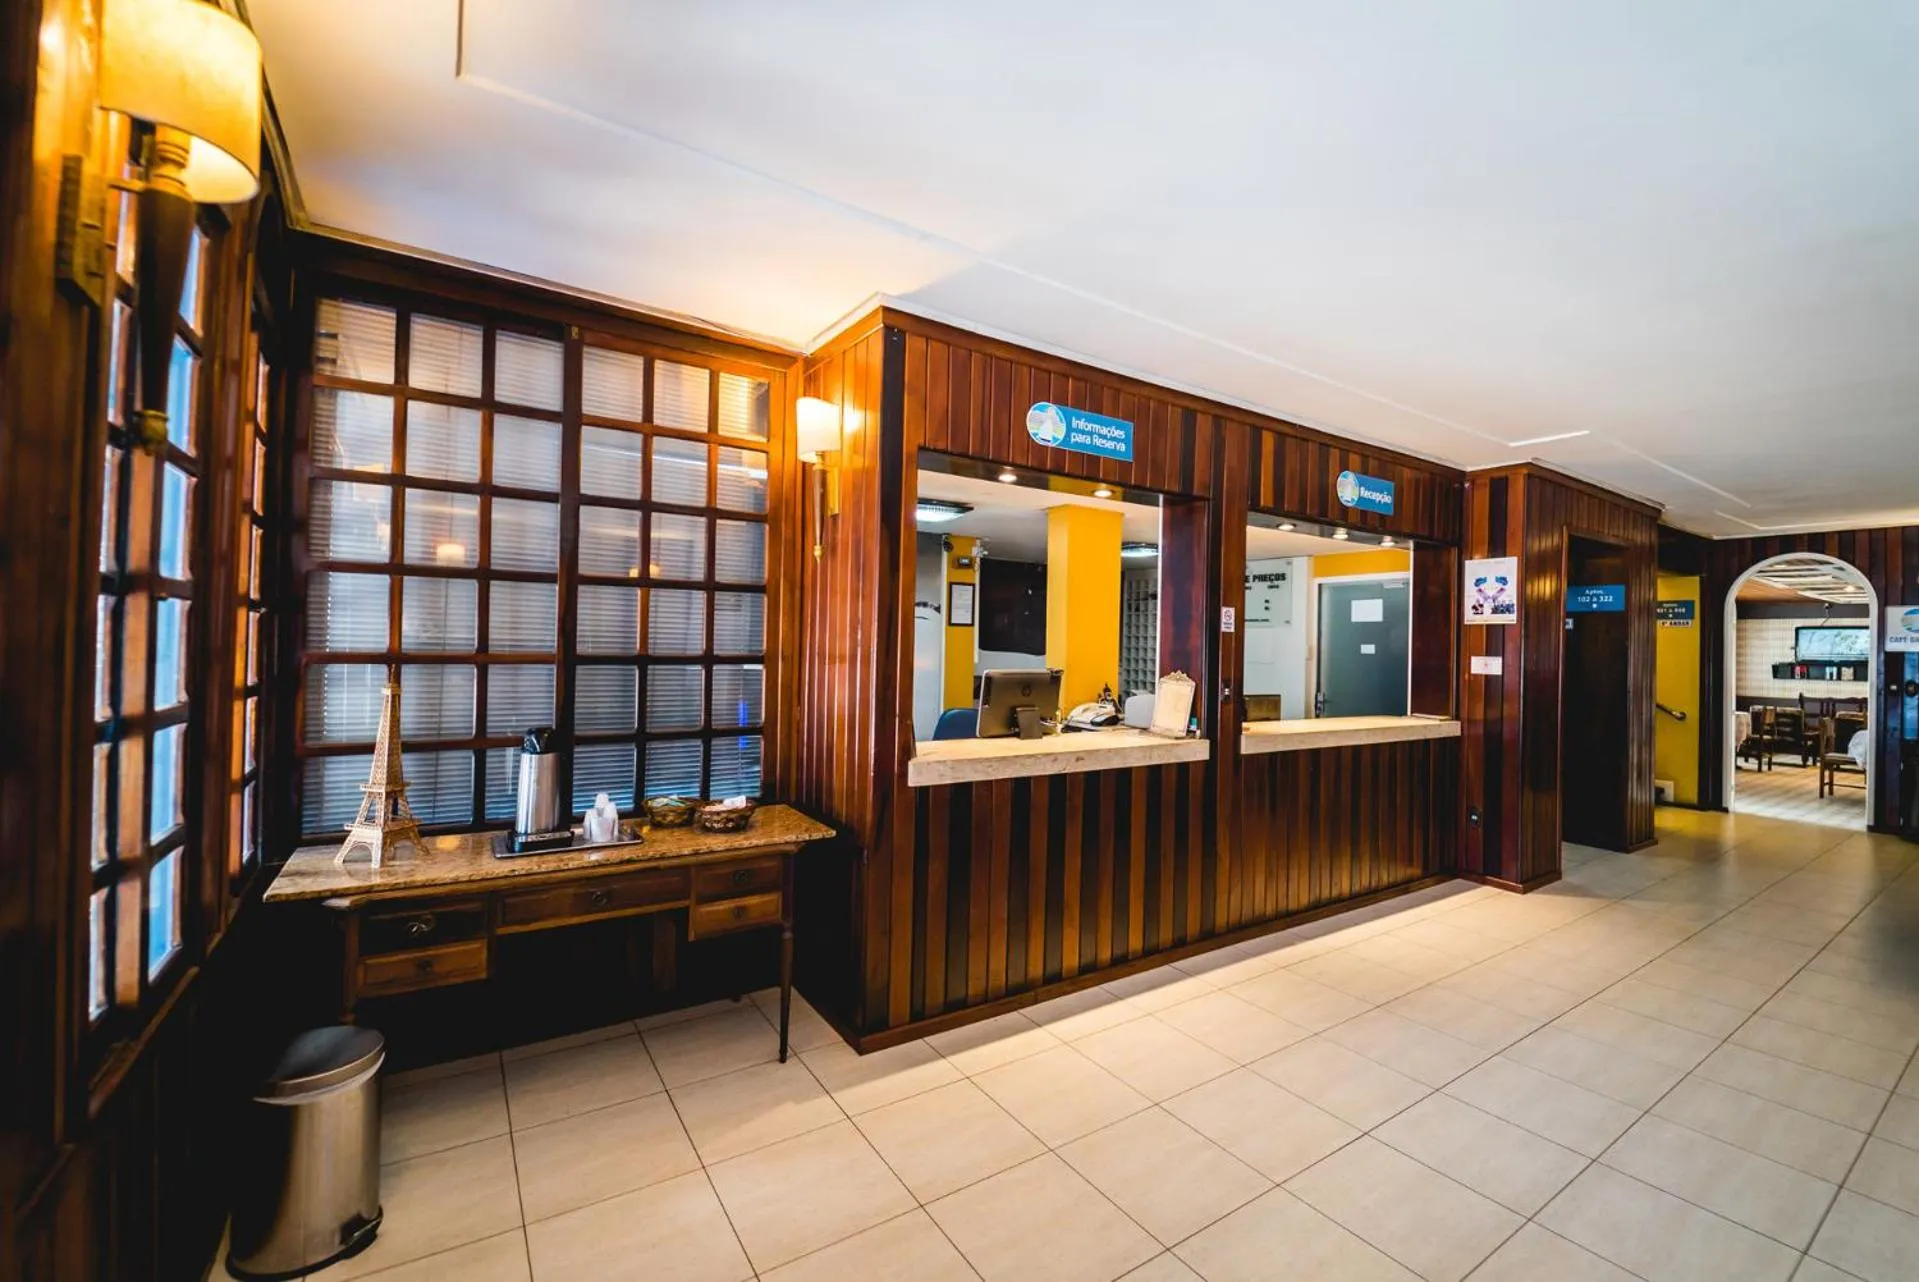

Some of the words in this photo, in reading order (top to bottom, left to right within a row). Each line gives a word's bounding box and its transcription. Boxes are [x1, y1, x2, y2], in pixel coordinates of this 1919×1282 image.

[1071, 416, 1126, 439] Informações
[1070, 433, 1092, 445] para
[1093, 434, 1126, 452] Reserva
[1360, 486, 1392, 504] Recepção
[1252, 573, 1286, 583] PREÇOS
